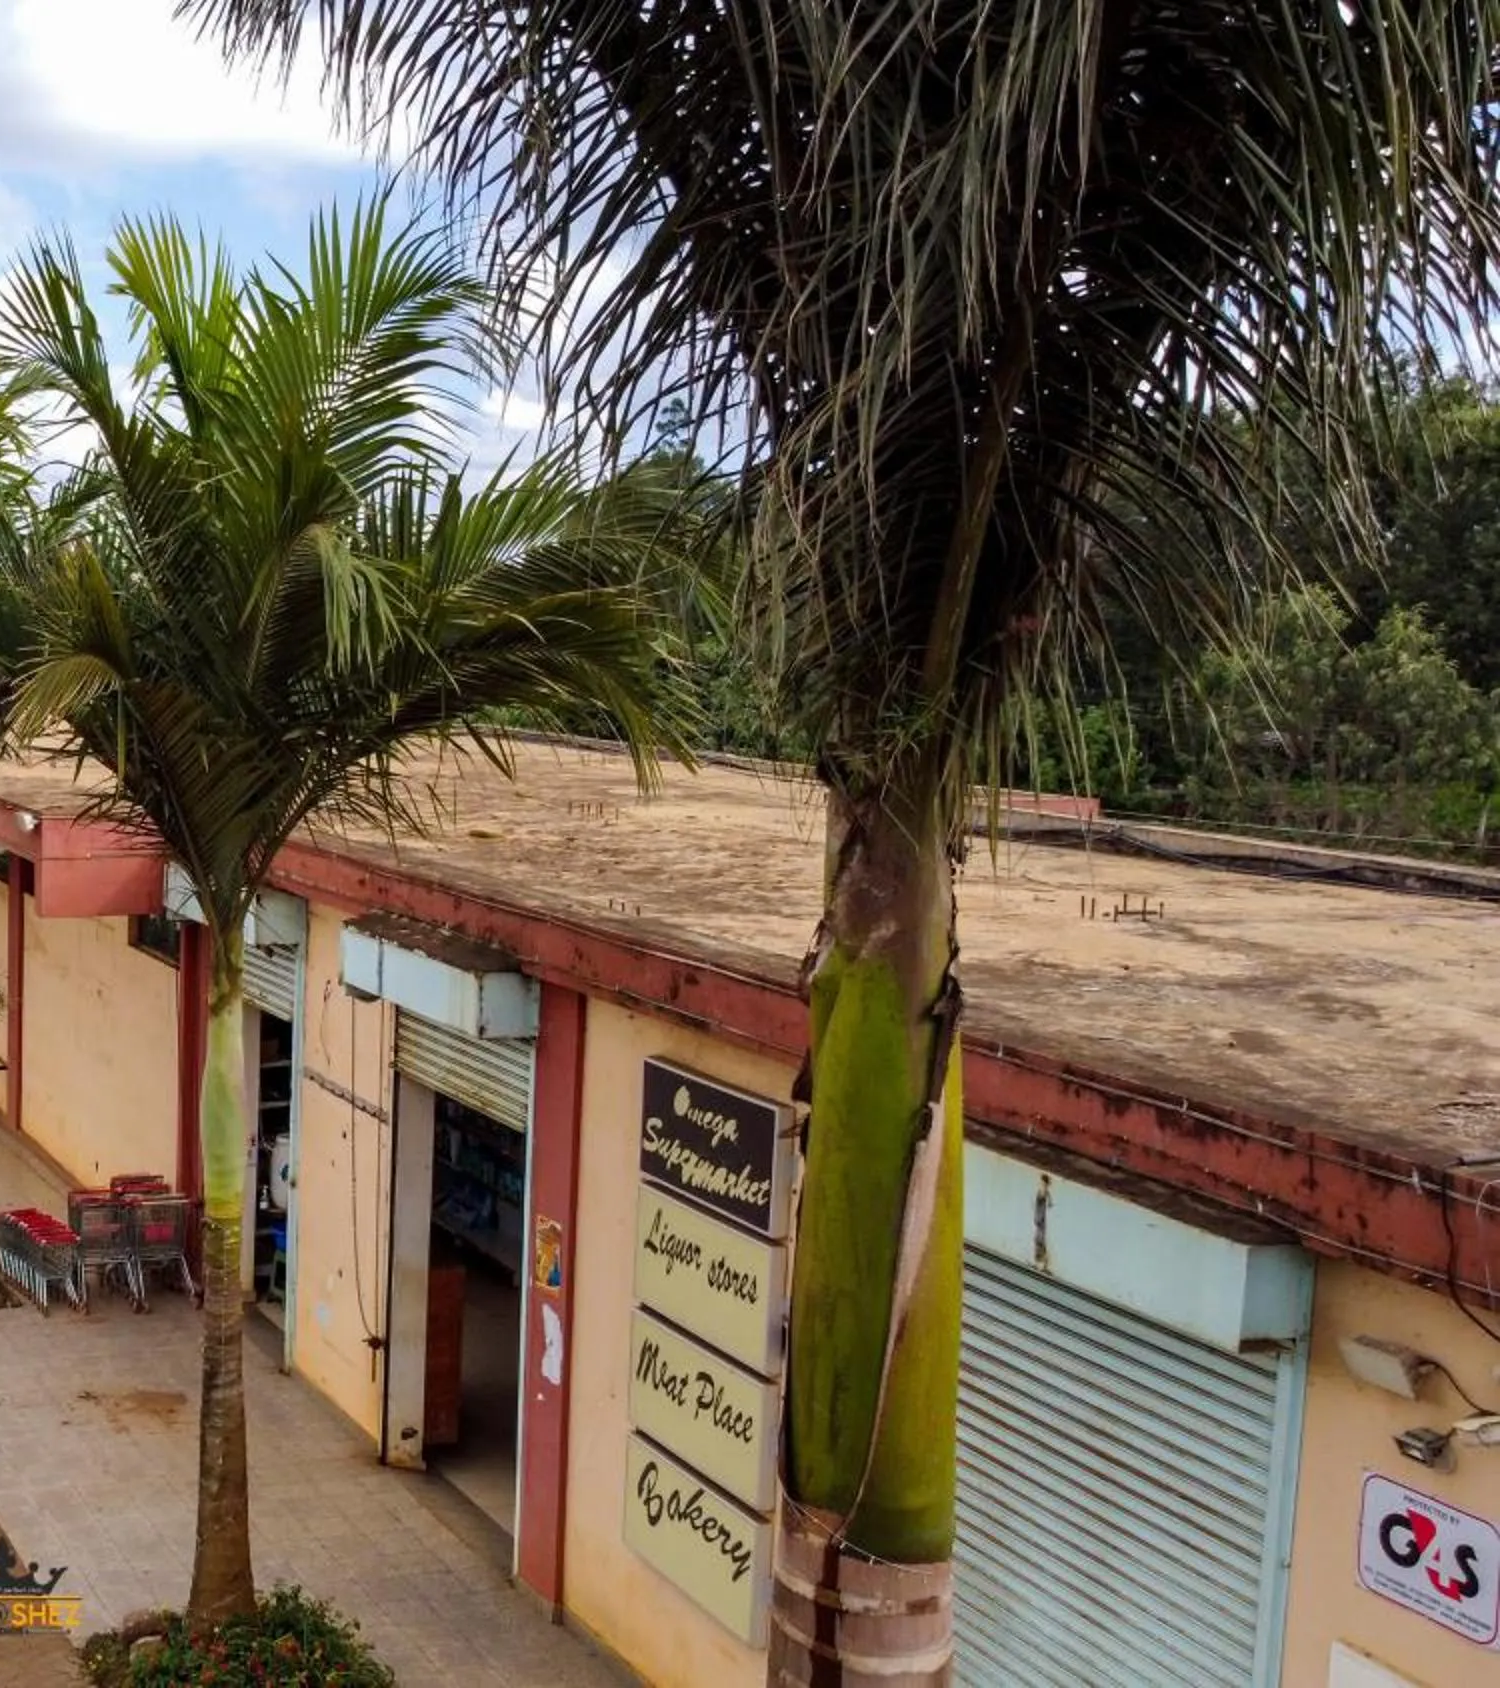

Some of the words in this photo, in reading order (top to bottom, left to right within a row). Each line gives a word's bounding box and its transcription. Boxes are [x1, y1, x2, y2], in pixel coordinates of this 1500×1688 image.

[643, 1117, 770, 1206] Supermarket
[673, 1085, 739, 1148] Omega
[643, 1208, 701, 1275] Liquor
[707, 1257, 757, 1305] stores
[636, 1337, 689, 1407] Meat
[693, 1371, 753, 1443] Place
[637, 1461, 751, 1582] Bakery
[1379, 1507, 1479, 1603] G4S
